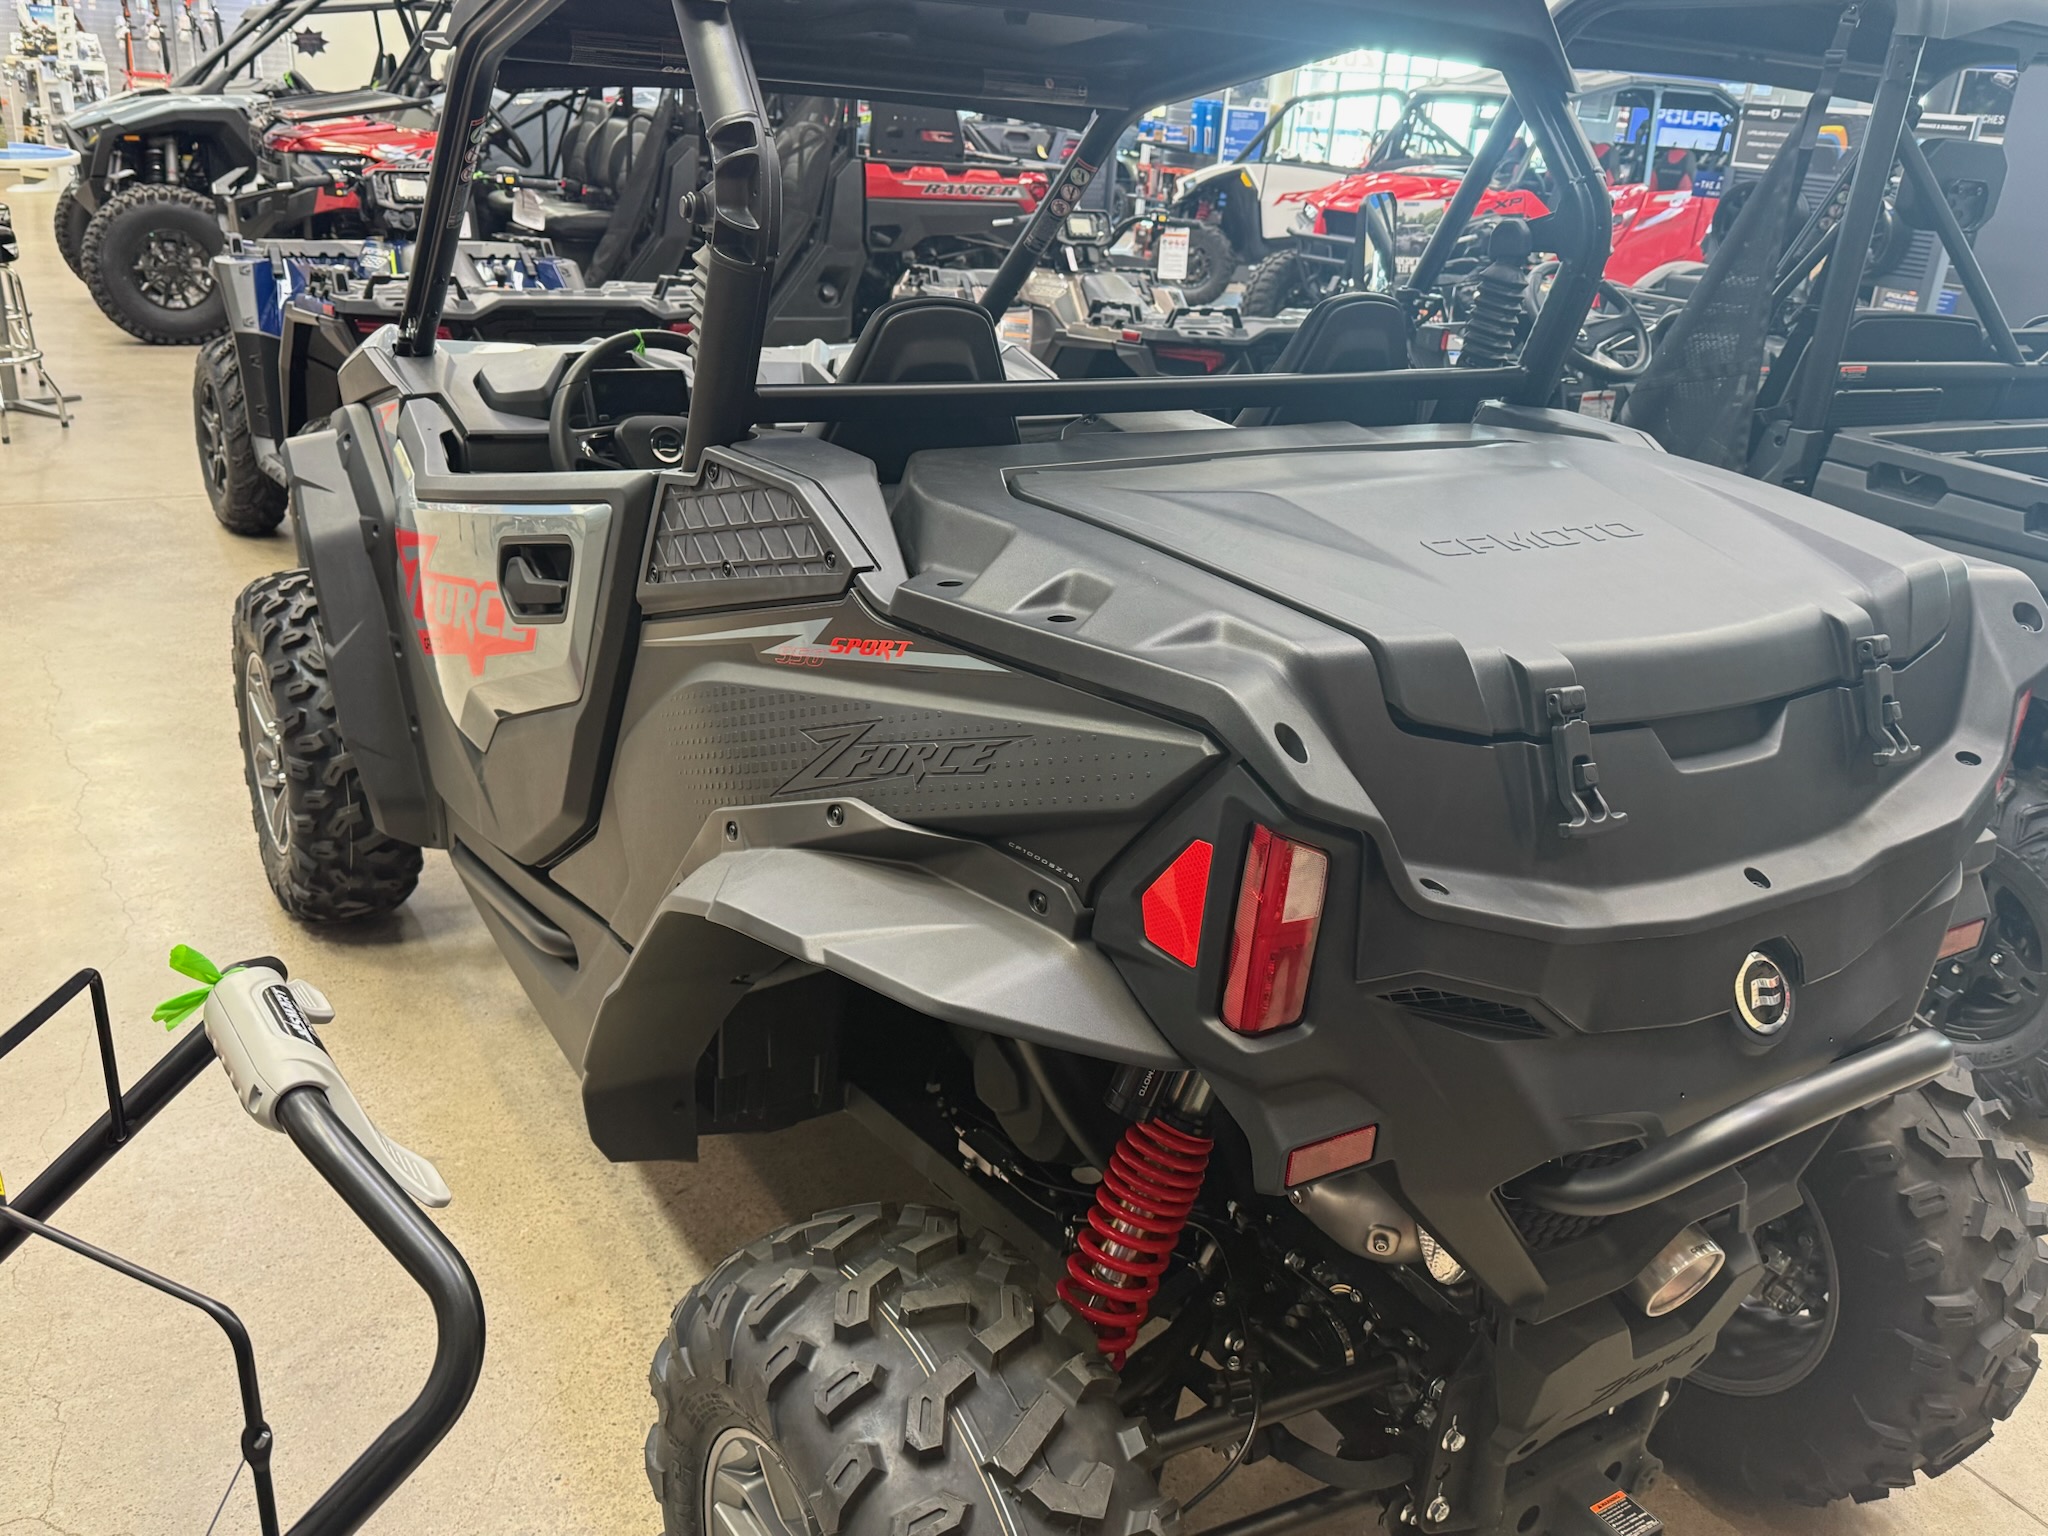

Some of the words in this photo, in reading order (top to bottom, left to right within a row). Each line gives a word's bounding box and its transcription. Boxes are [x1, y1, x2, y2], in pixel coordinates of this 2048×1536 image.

[923, 183, 1018, 197] RANGER
[1494, 196, 1523, 209] XP
[1419, 523, 1644, 556] CFMOTO
[828, 637, 914, 662] SPORT
[771, 717, 1034, 798] ZFORCE
[1138, 1068, 1156, 1097] MOTO
